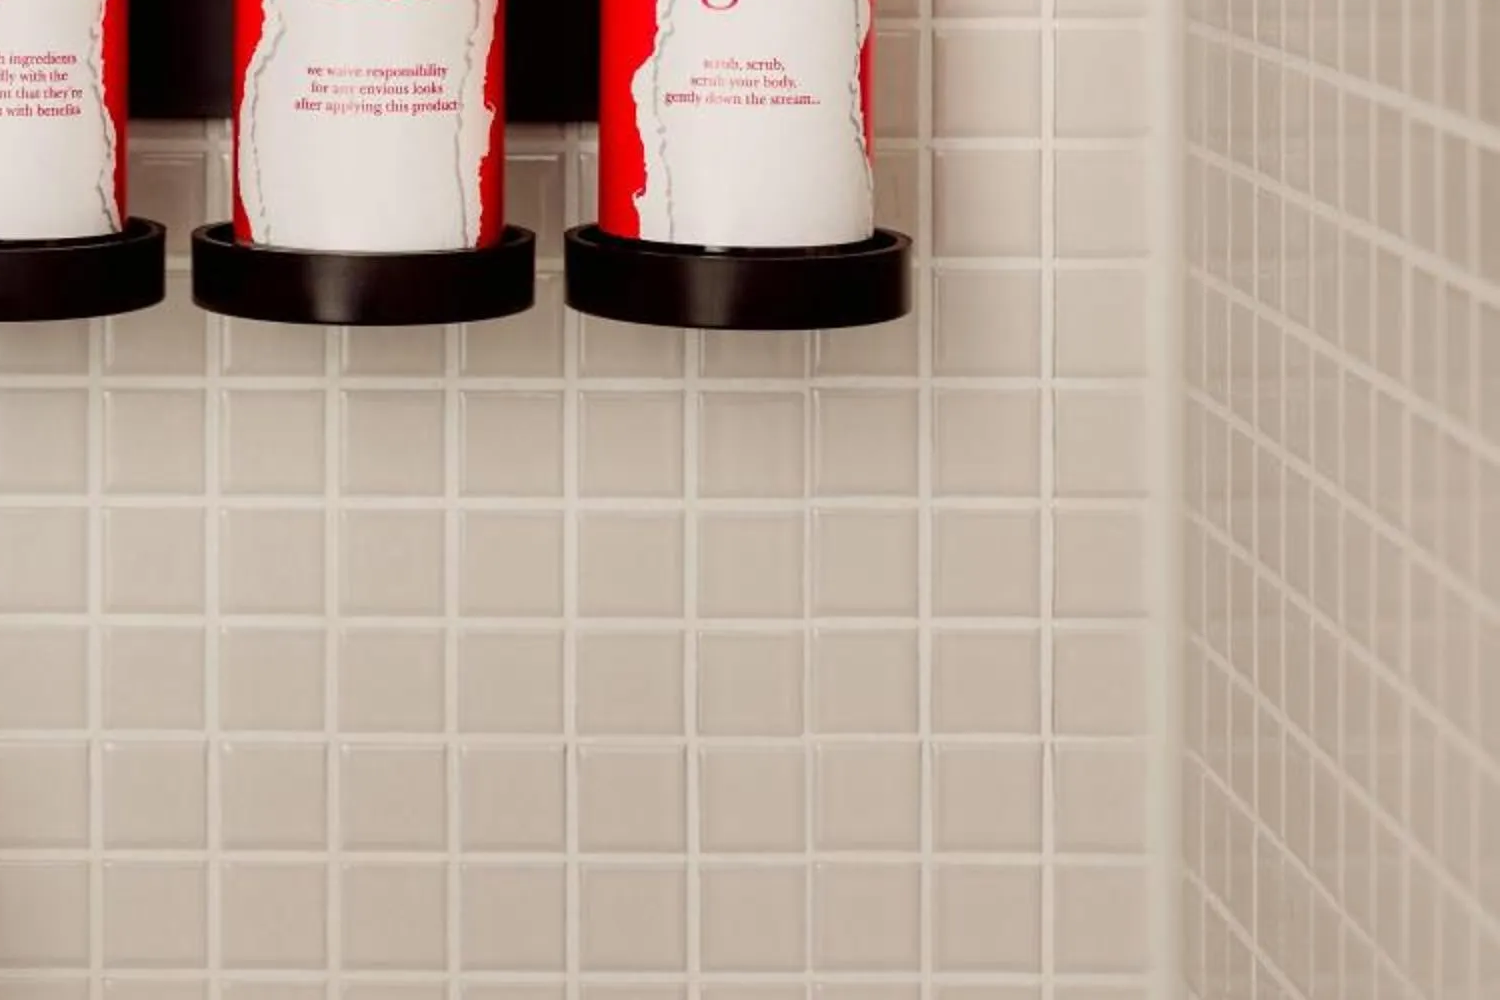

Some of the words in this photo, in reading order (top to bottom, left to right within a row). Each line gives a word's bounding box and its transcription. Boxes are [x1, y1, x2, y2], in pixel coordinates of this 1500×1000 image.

[746, 58, 785, 71] scrub,
[19, 70, 47, 81] with
[50, 70, 68, 81] the
[307, 66, 323, 77] we
[366, 64, 448, 81] responsibility
[311, 81, 327, 93] for
[359, 83, 409, 95] envious
[412, 82, 443, 95] looks
[728, 78, 760, 89] your
[15, 87, 39, 99] that
[745, 92, 766, 105] the
[5, 104, 32, 117] with
[37, 104, 81, 117] benefits
[295, 99, 322, 111] after
[325, 99, 383, 115] applying
[386, 99, 409, 112] this
